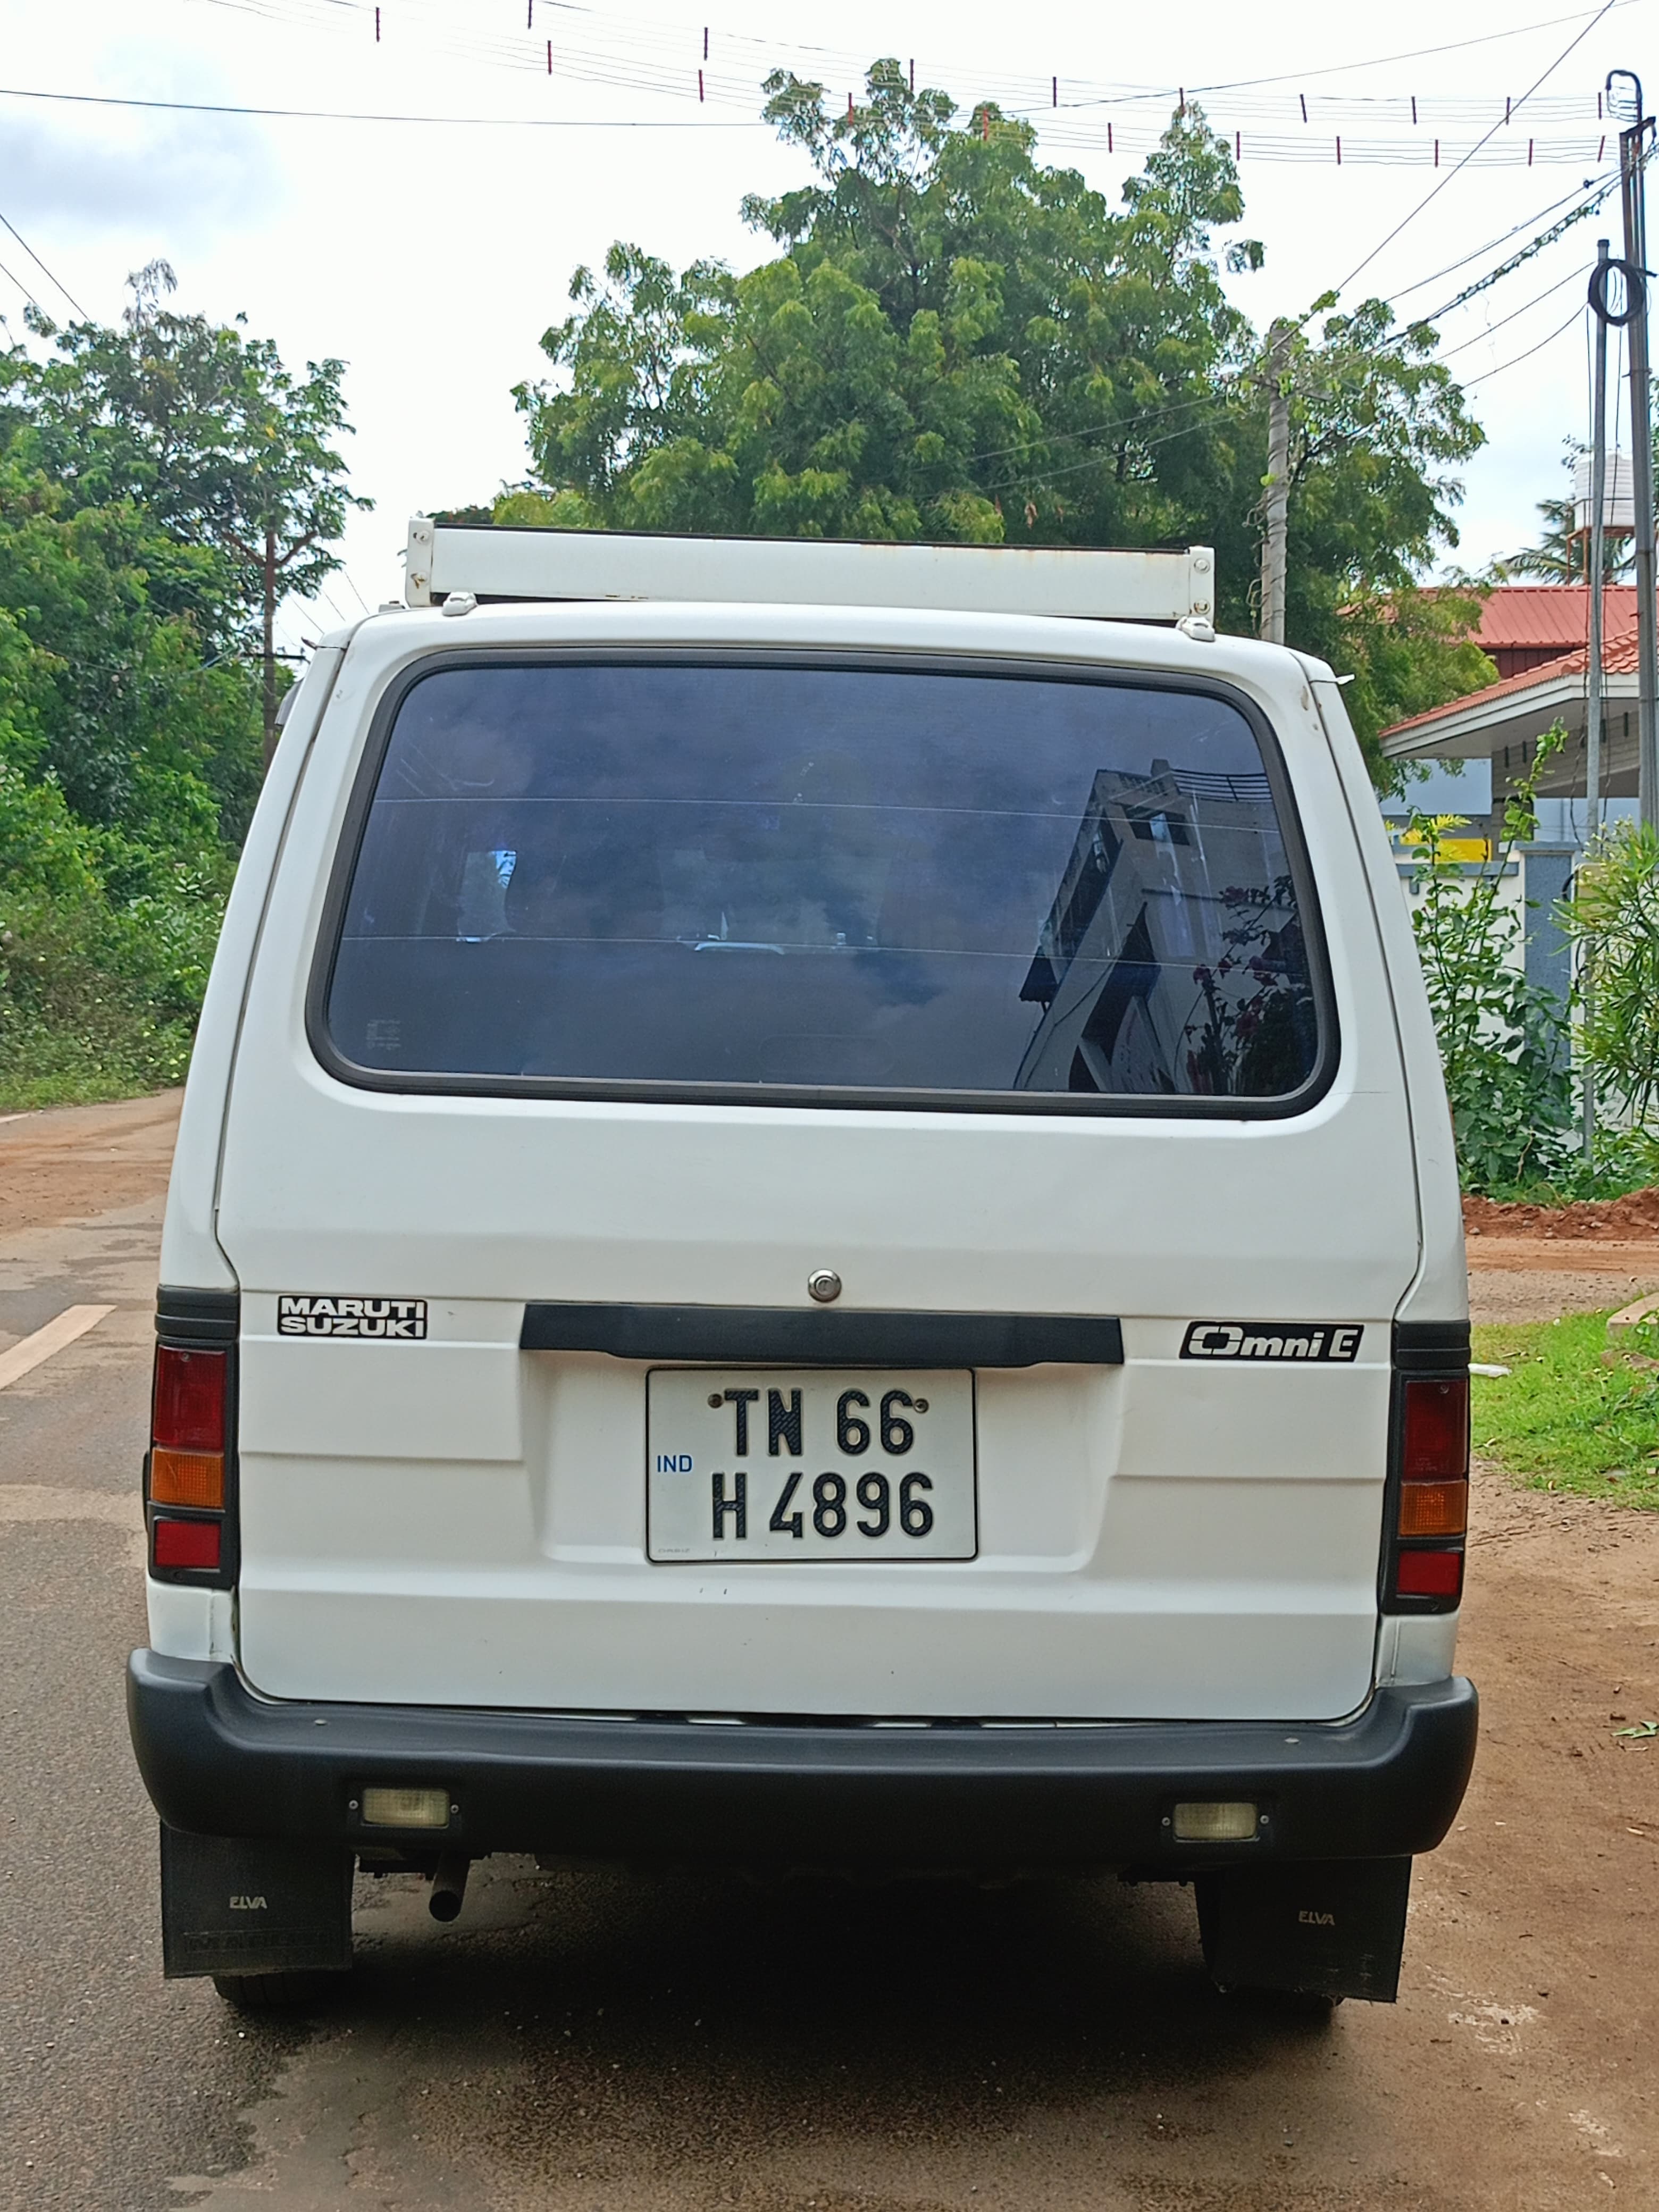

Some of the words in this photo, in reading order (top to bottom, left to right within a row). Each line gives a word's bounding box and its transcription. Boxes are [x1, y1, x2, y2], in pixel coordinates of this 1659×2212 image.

[281, 1297, 424, 1318] MARUTI
[280, 1316, 424, 1337] SUZUKI
[1188, 1326, 1325, 1358] Omni
[1328, 1329, 1359, 1358] E
[724, 1388, 803, 1456] TN
[836, 1388, 915, 1455] 66
[657, 1454, 692, 1472] IND
[711, 1472, 747, 1539] H
[769, 1472, 934, 1538] 4896
[229, 1896, 268, 1909] ELVA
[1297, 1910, 1336, 1926] ELVA
